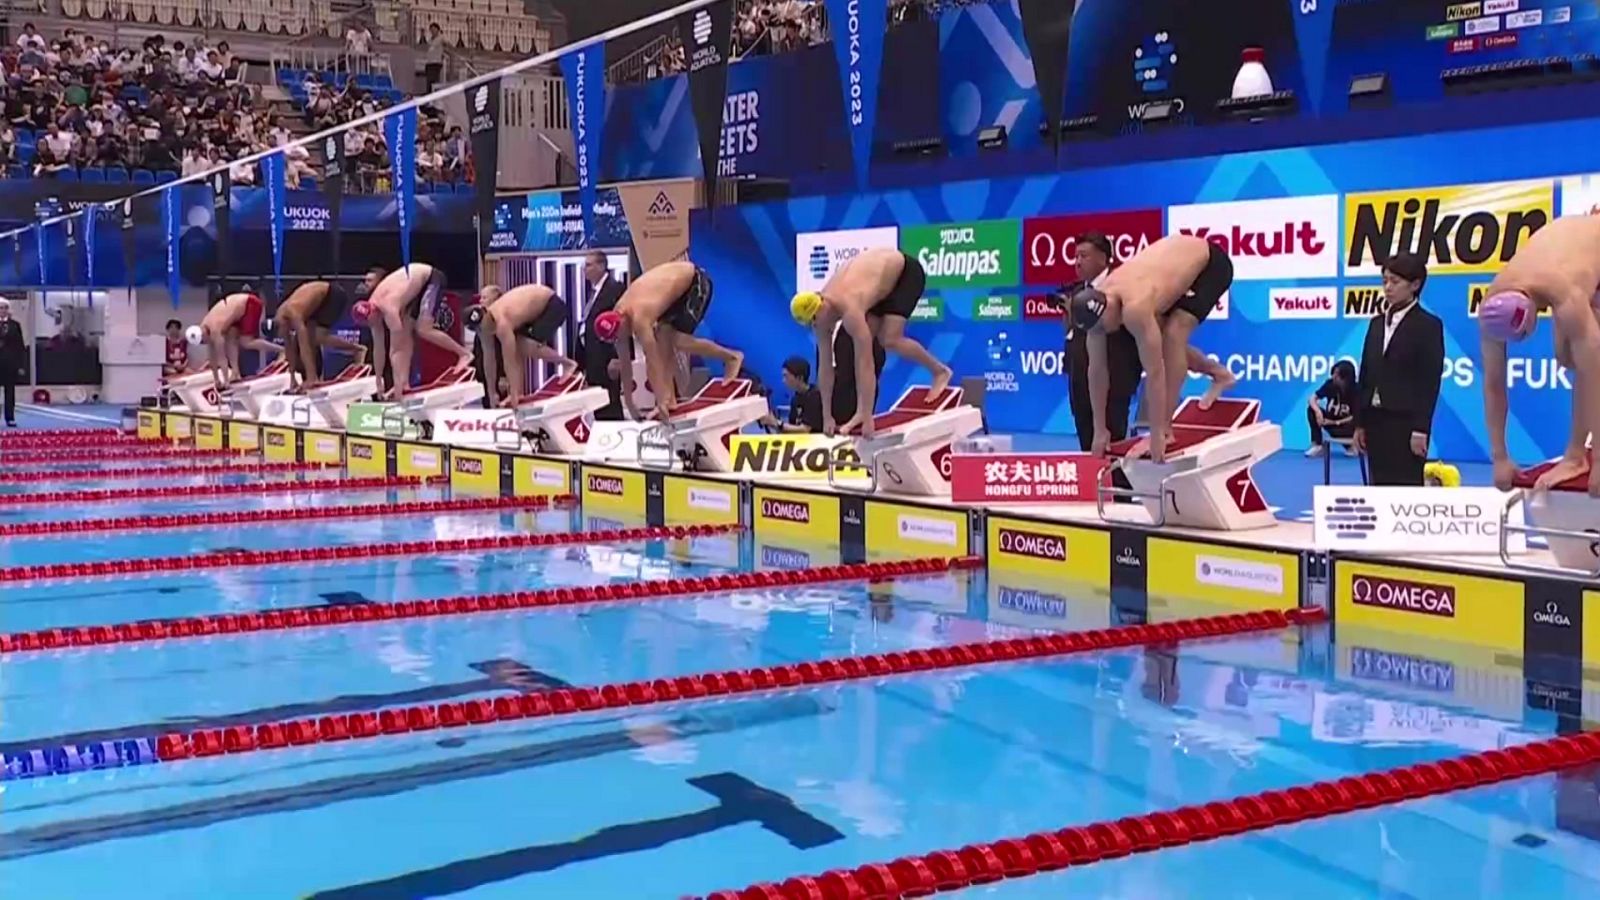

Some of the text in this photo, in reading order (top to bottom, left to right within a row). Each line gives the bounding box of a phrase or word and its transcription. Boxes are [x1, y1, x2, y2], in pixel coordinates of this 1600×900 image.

[1448, 5, 1480, 19] Nikon
[850, 70, 863, 126] 2023
[576, 51, 588, 188] FUKUOKA 2023
[719, 122, 758, 157] EETS
[283, 206, 331, 220] UKUOK
[292, 219, 325, 231] 2023
[1347, 198, 1548, 268] Nikon
[918, 246, 1000, 282] Salonpas
[1274, 297, 1332, 311] Yakult
[1345, 290, 1388, 315] Nik
[1020, 351, 1065, 375] WOR
[1506, 358, 1573, 390] FUK
[444, 419, 520, 433] Yakul
[573, 422, 585, 441] 4
[734, 439, 862, 473] Nikon
[941, 453, 952, 476] 6
[984, 461, 1079, 483] 农夫山泉
[595, 478, 623, 494] OMEGA
[985, 484, 1079, 496] NONGFU SPRING
[1237, 479, 1251, 507] 7
[773, 502, 809, 521] OMEGA
[1390, 503, 1482, 519] WORLD
[1391, 520, 1497, 536] AQUATIC
[1014, 538, 1065, 558] OMEGA
[1116, 555, 1141, 566] OMEGA
[1376, 583, 1454, 614] OMEGA
[1533, 612, 1571, 626] OMEGA
